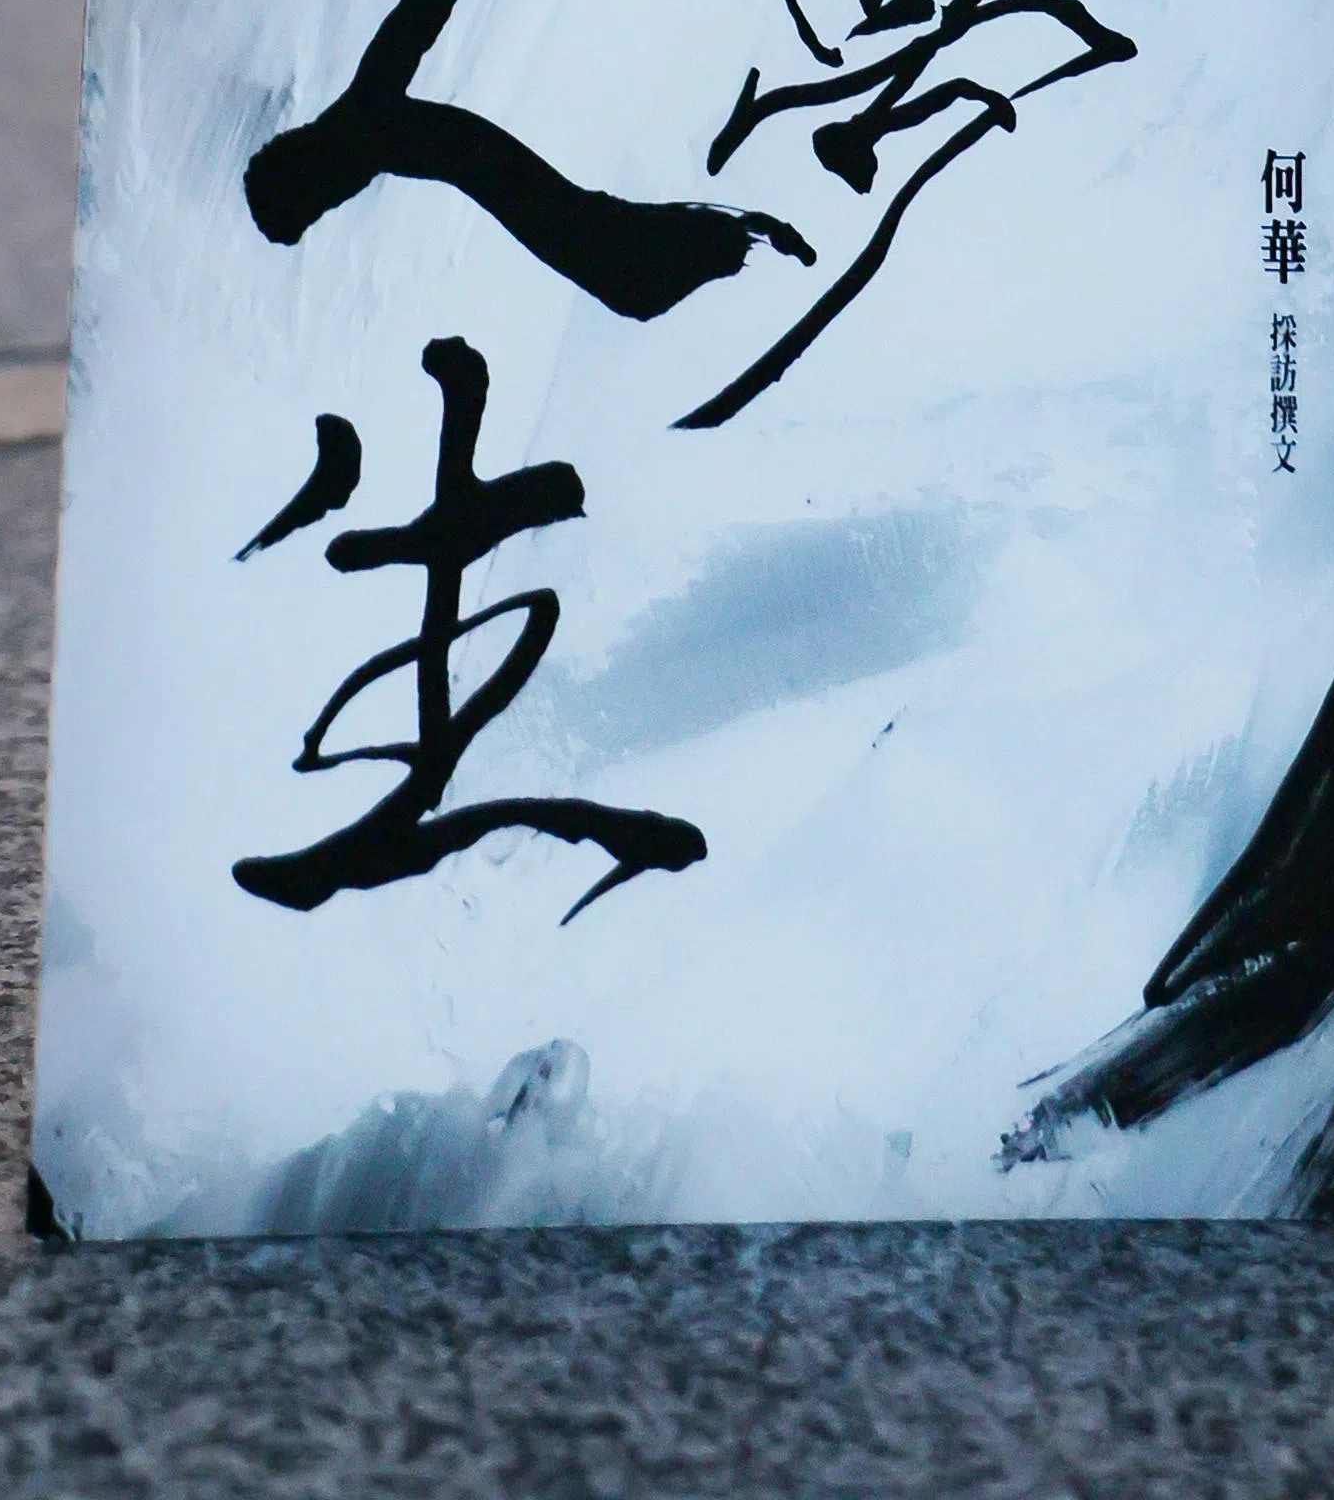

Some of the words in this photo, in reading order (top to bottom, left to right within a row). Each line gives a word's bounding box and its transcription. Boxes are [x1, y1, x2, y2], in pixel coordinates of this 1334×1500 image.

[1260, 148, 1307, 285] 何華
[1269, 312, 1298, 474] 採訪撰文
